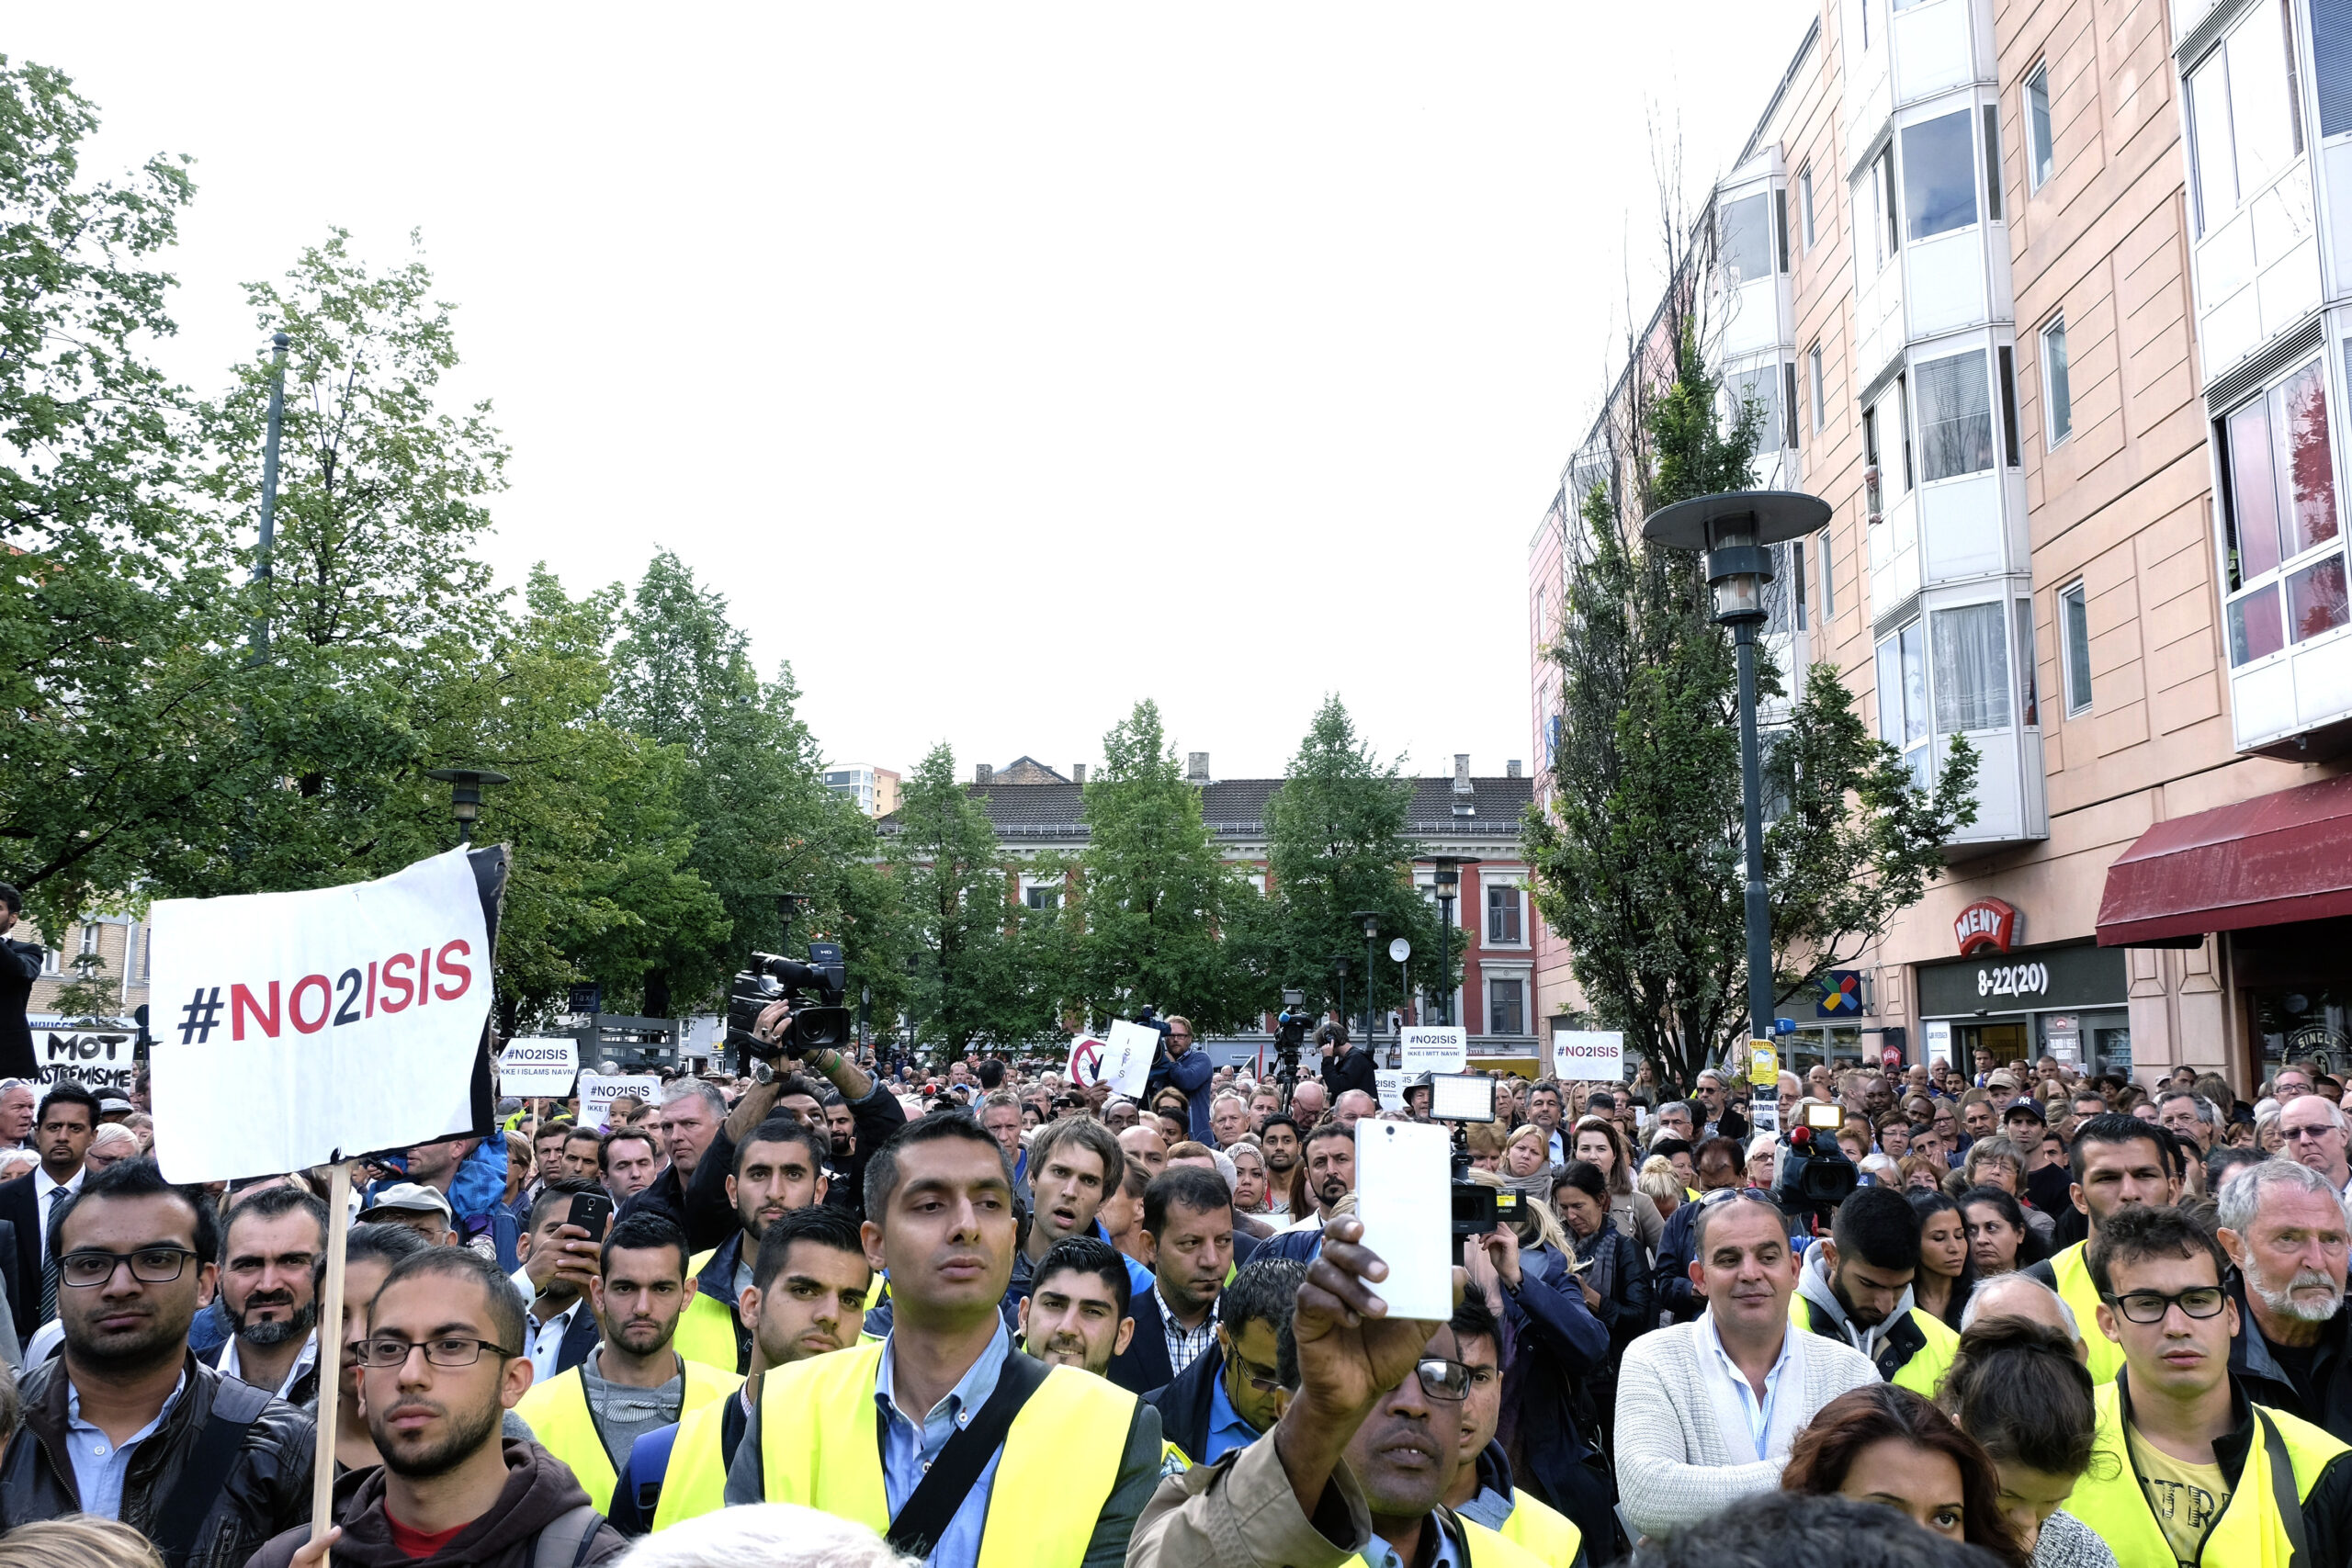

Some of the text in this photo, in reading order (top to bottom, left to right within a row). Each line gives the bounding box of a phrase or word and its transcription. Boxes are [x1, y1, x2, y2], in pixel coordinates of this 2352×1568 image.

[1956, 908, 2002, 943] MENY
[1977, 962, 2049, 998] 8-22(20)
[176, 939, 472, 1045] #NO2ISIS
[574, 992, 594, 1001] Taxi
[47, 1032, 130, 1061] MOT
[1409, 1034, 1457, 1044] #NO2ISIS
[2298, 1032, 2338, 1049] SINGLE
[507, 1048, 568, 1060] #NO2ISIS
[1557, 1045, 1619, 1057] #NO2ISIS
[29, 1063, 131, 1088] KSTREMISME
[1375, 1079, 1396, 1089] 2ISIS
